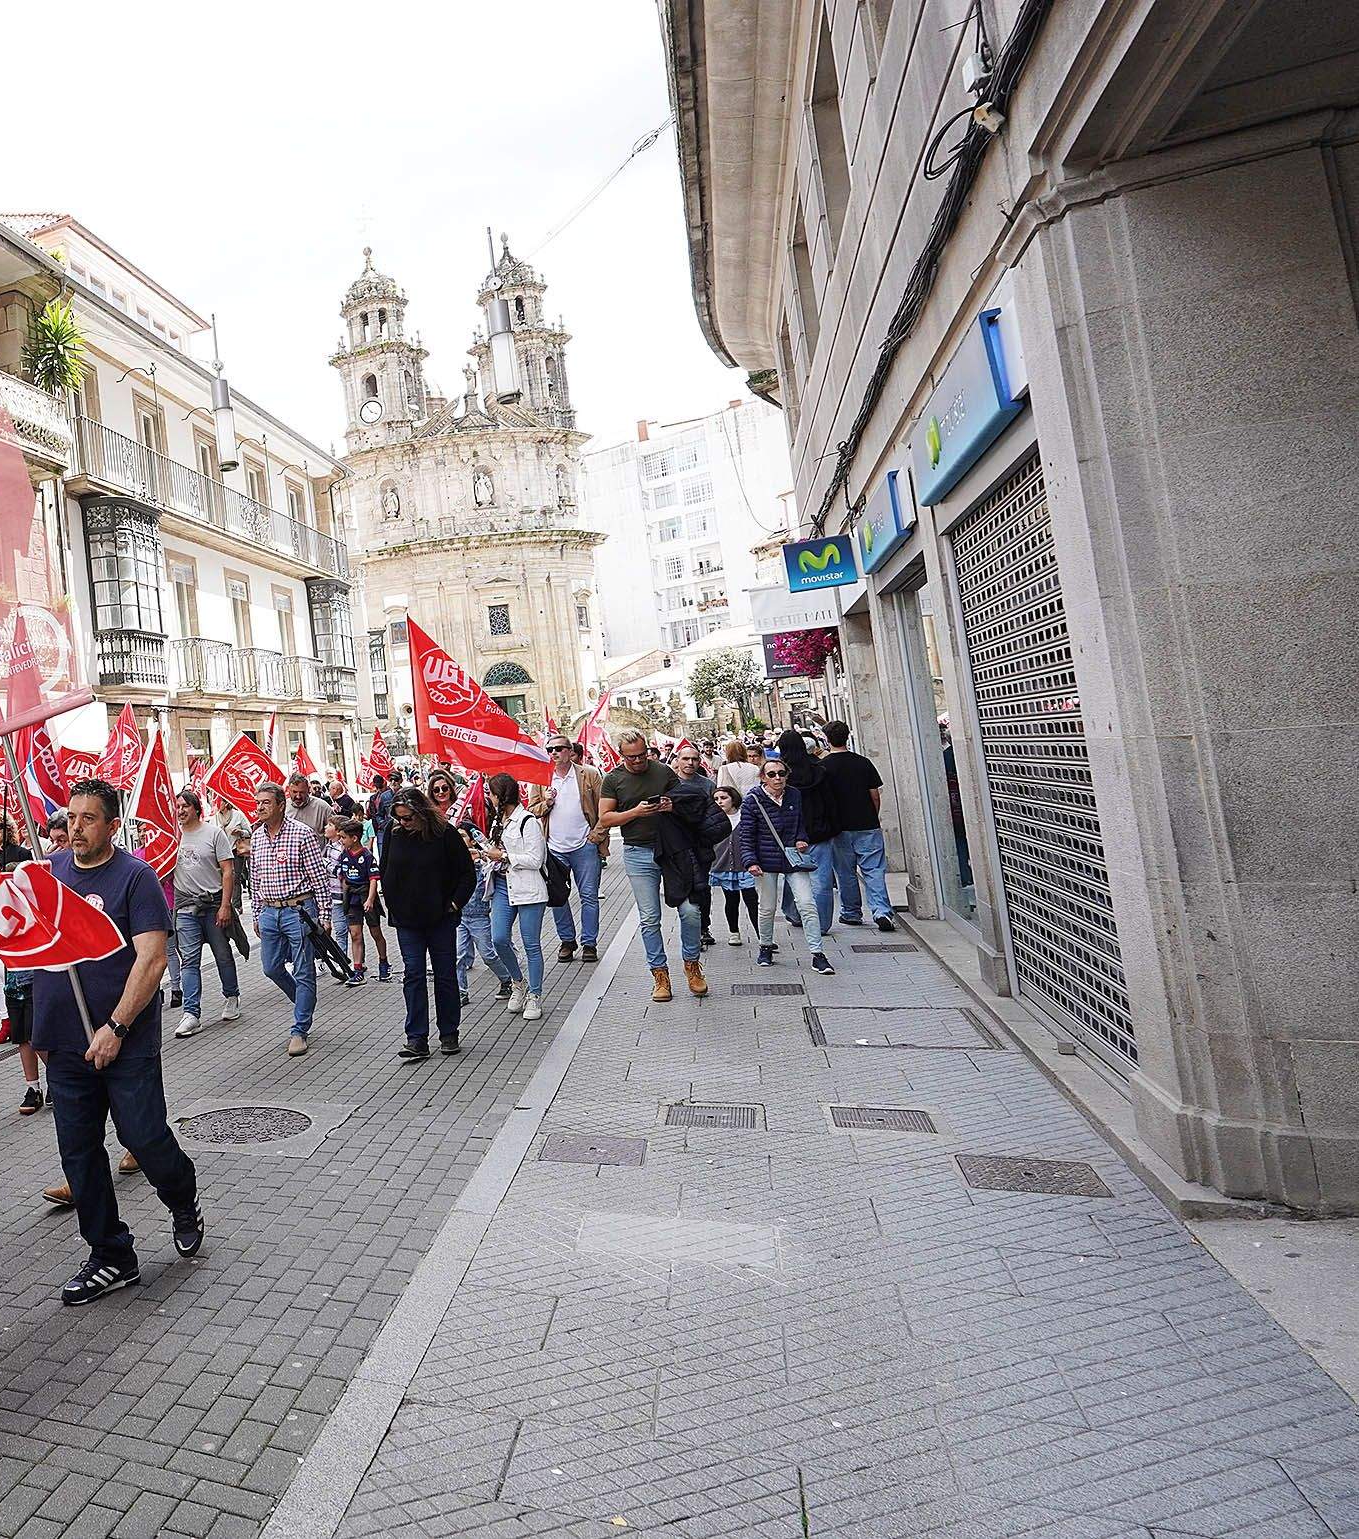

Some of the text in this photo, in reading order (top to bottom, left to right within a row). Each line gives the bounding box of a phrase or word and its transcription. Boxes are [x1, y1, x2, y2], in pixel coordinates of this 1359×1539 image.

[801, 571, 844, 585] movistar
[423, 656, 470, 690] UGT
[440, 725, 479, 744] Galicia
